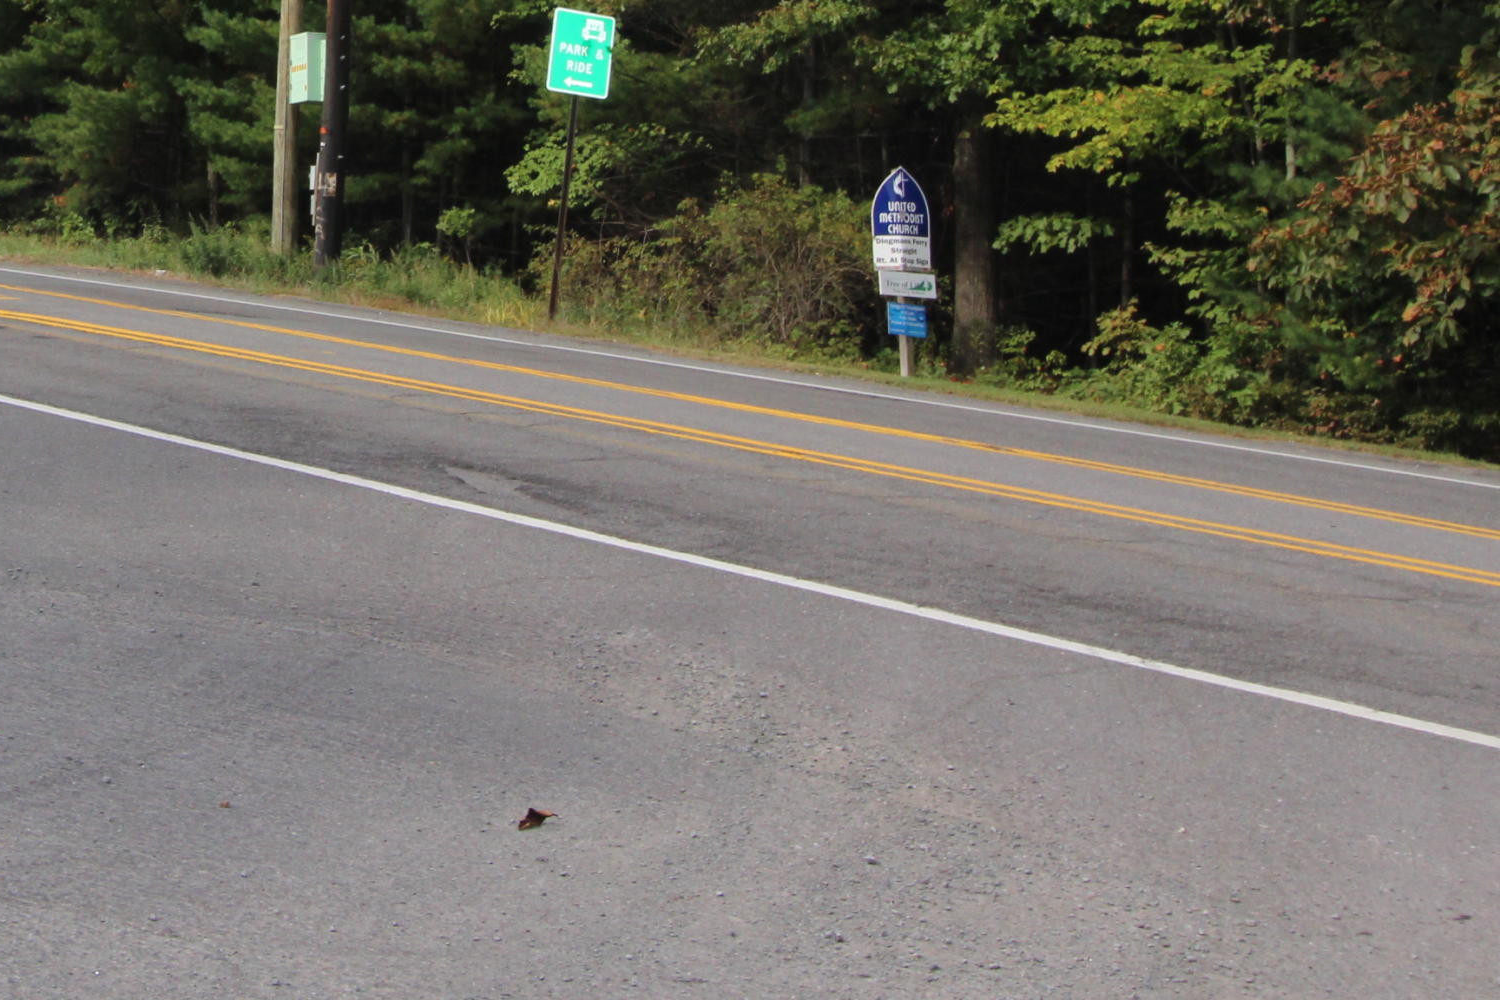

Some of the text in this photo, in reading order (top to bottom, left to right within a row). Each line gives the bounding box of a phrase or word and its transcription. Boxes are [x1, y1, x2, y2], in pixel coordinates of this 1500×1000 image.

[560, 42, 604, 61] PARK &
[567, 61, 593, 75] RIDE
[888, 202, 917, 212] UNITED
[880, 213, 924, 224] METHODIST
[888, 224, 919, 235] CHURCH
[912, 238, 928, 247] Ferry
